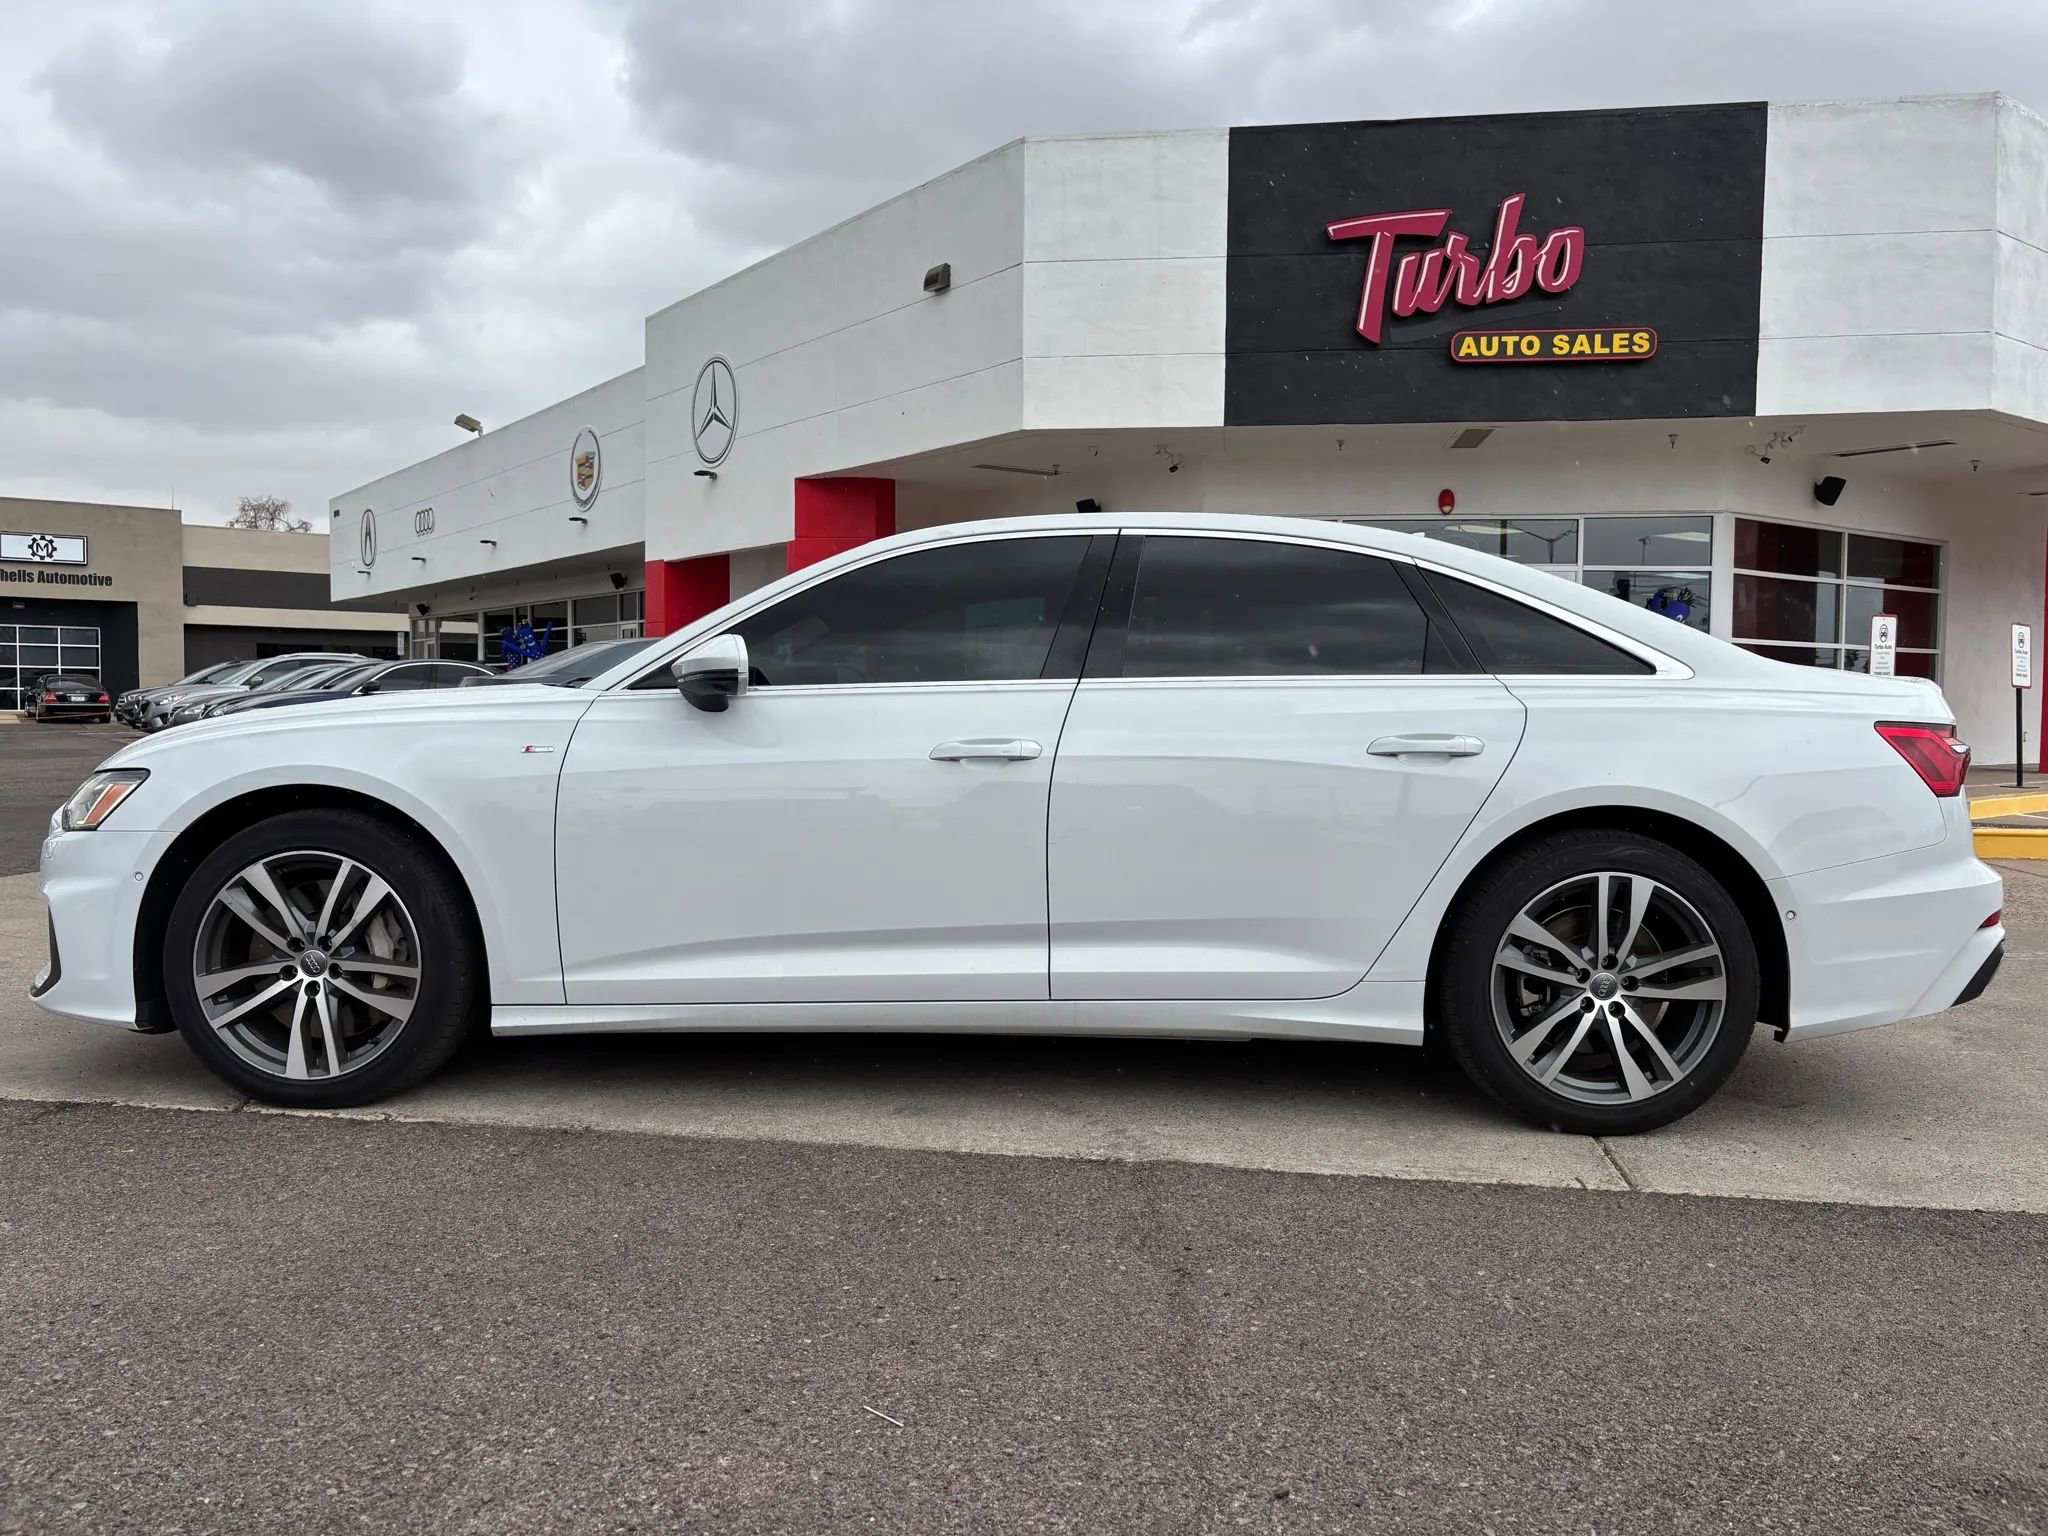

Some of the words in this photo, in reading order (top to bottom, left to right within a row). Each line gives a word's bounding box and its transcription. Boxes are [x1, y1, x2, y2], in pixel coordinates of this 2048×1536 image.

[1327, 192, 1585, 343] Turbo
[1458, 335, 1541, 357] AUTO
[1552, 332, 1650, 355] SALES
[37, 570, 113, 587] Automotive
